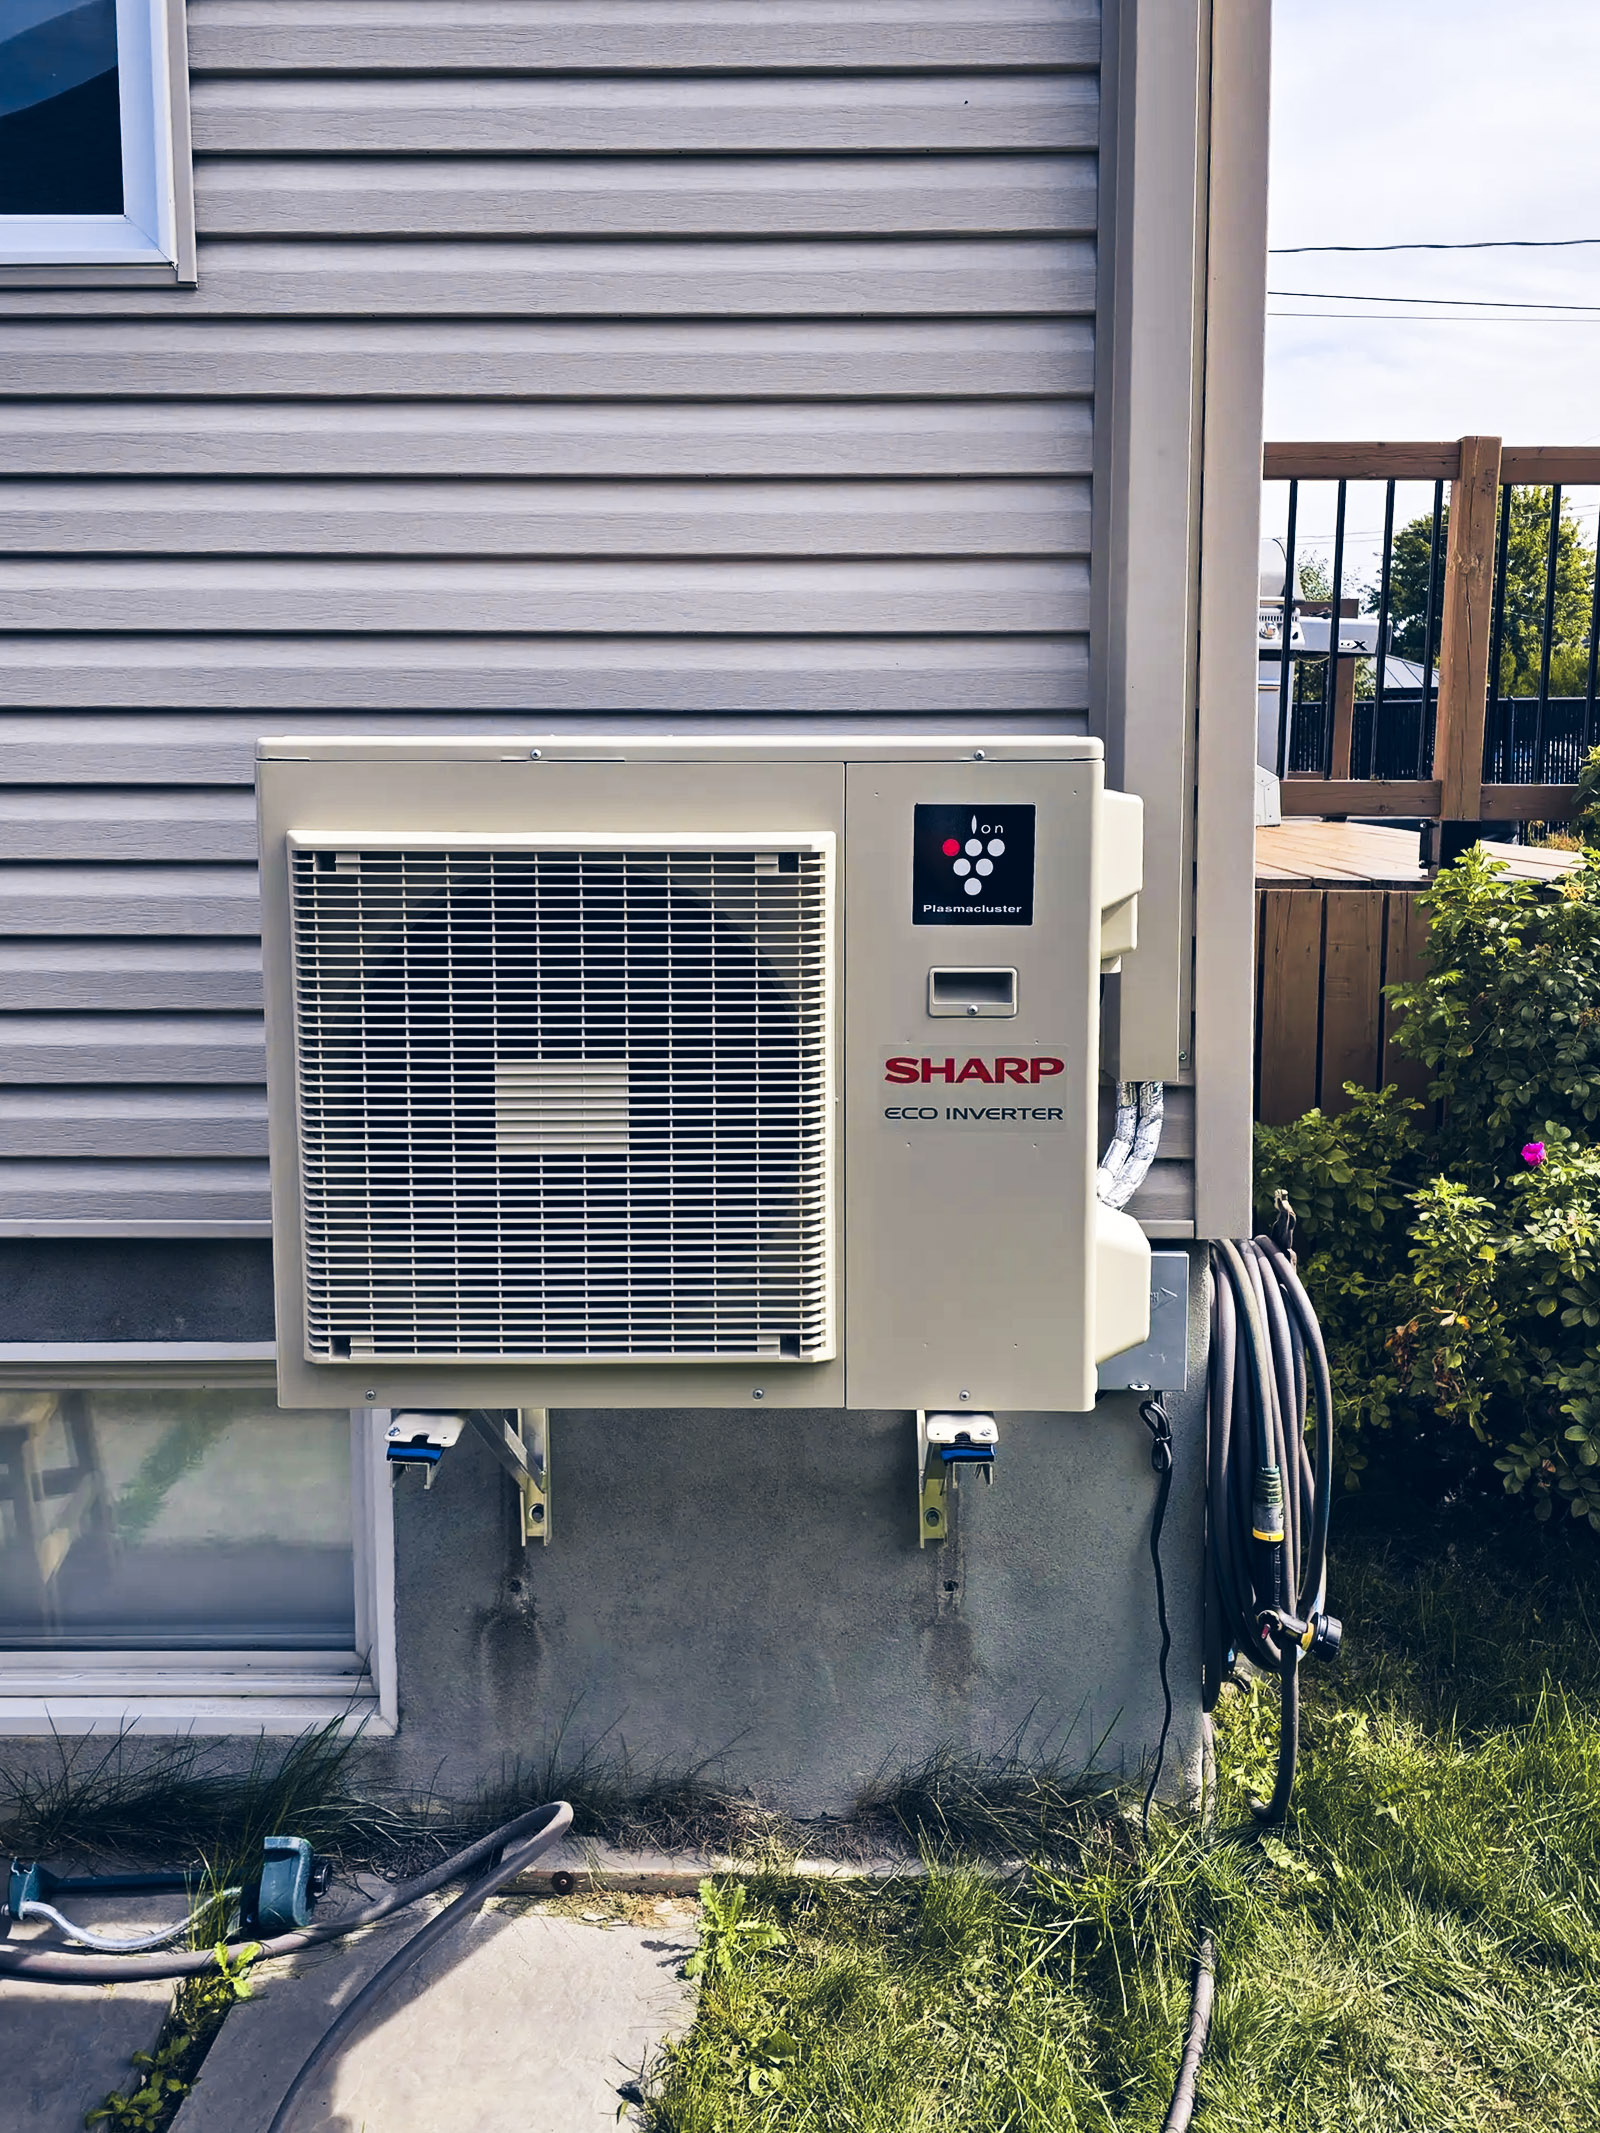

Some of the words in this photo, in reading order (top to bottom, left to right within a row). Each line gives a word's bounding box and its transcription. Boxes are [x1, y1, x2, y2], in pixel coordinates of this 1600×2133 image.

[971, 814, 1004, 835] Ion
[923, 904, 1022, 914] Plasmacluster
[885, 1057, 1065, 1084] SHARP
[884, 1107, 939, 1120] ECO
[945, 1107, 1064, 1121] INVERTER
